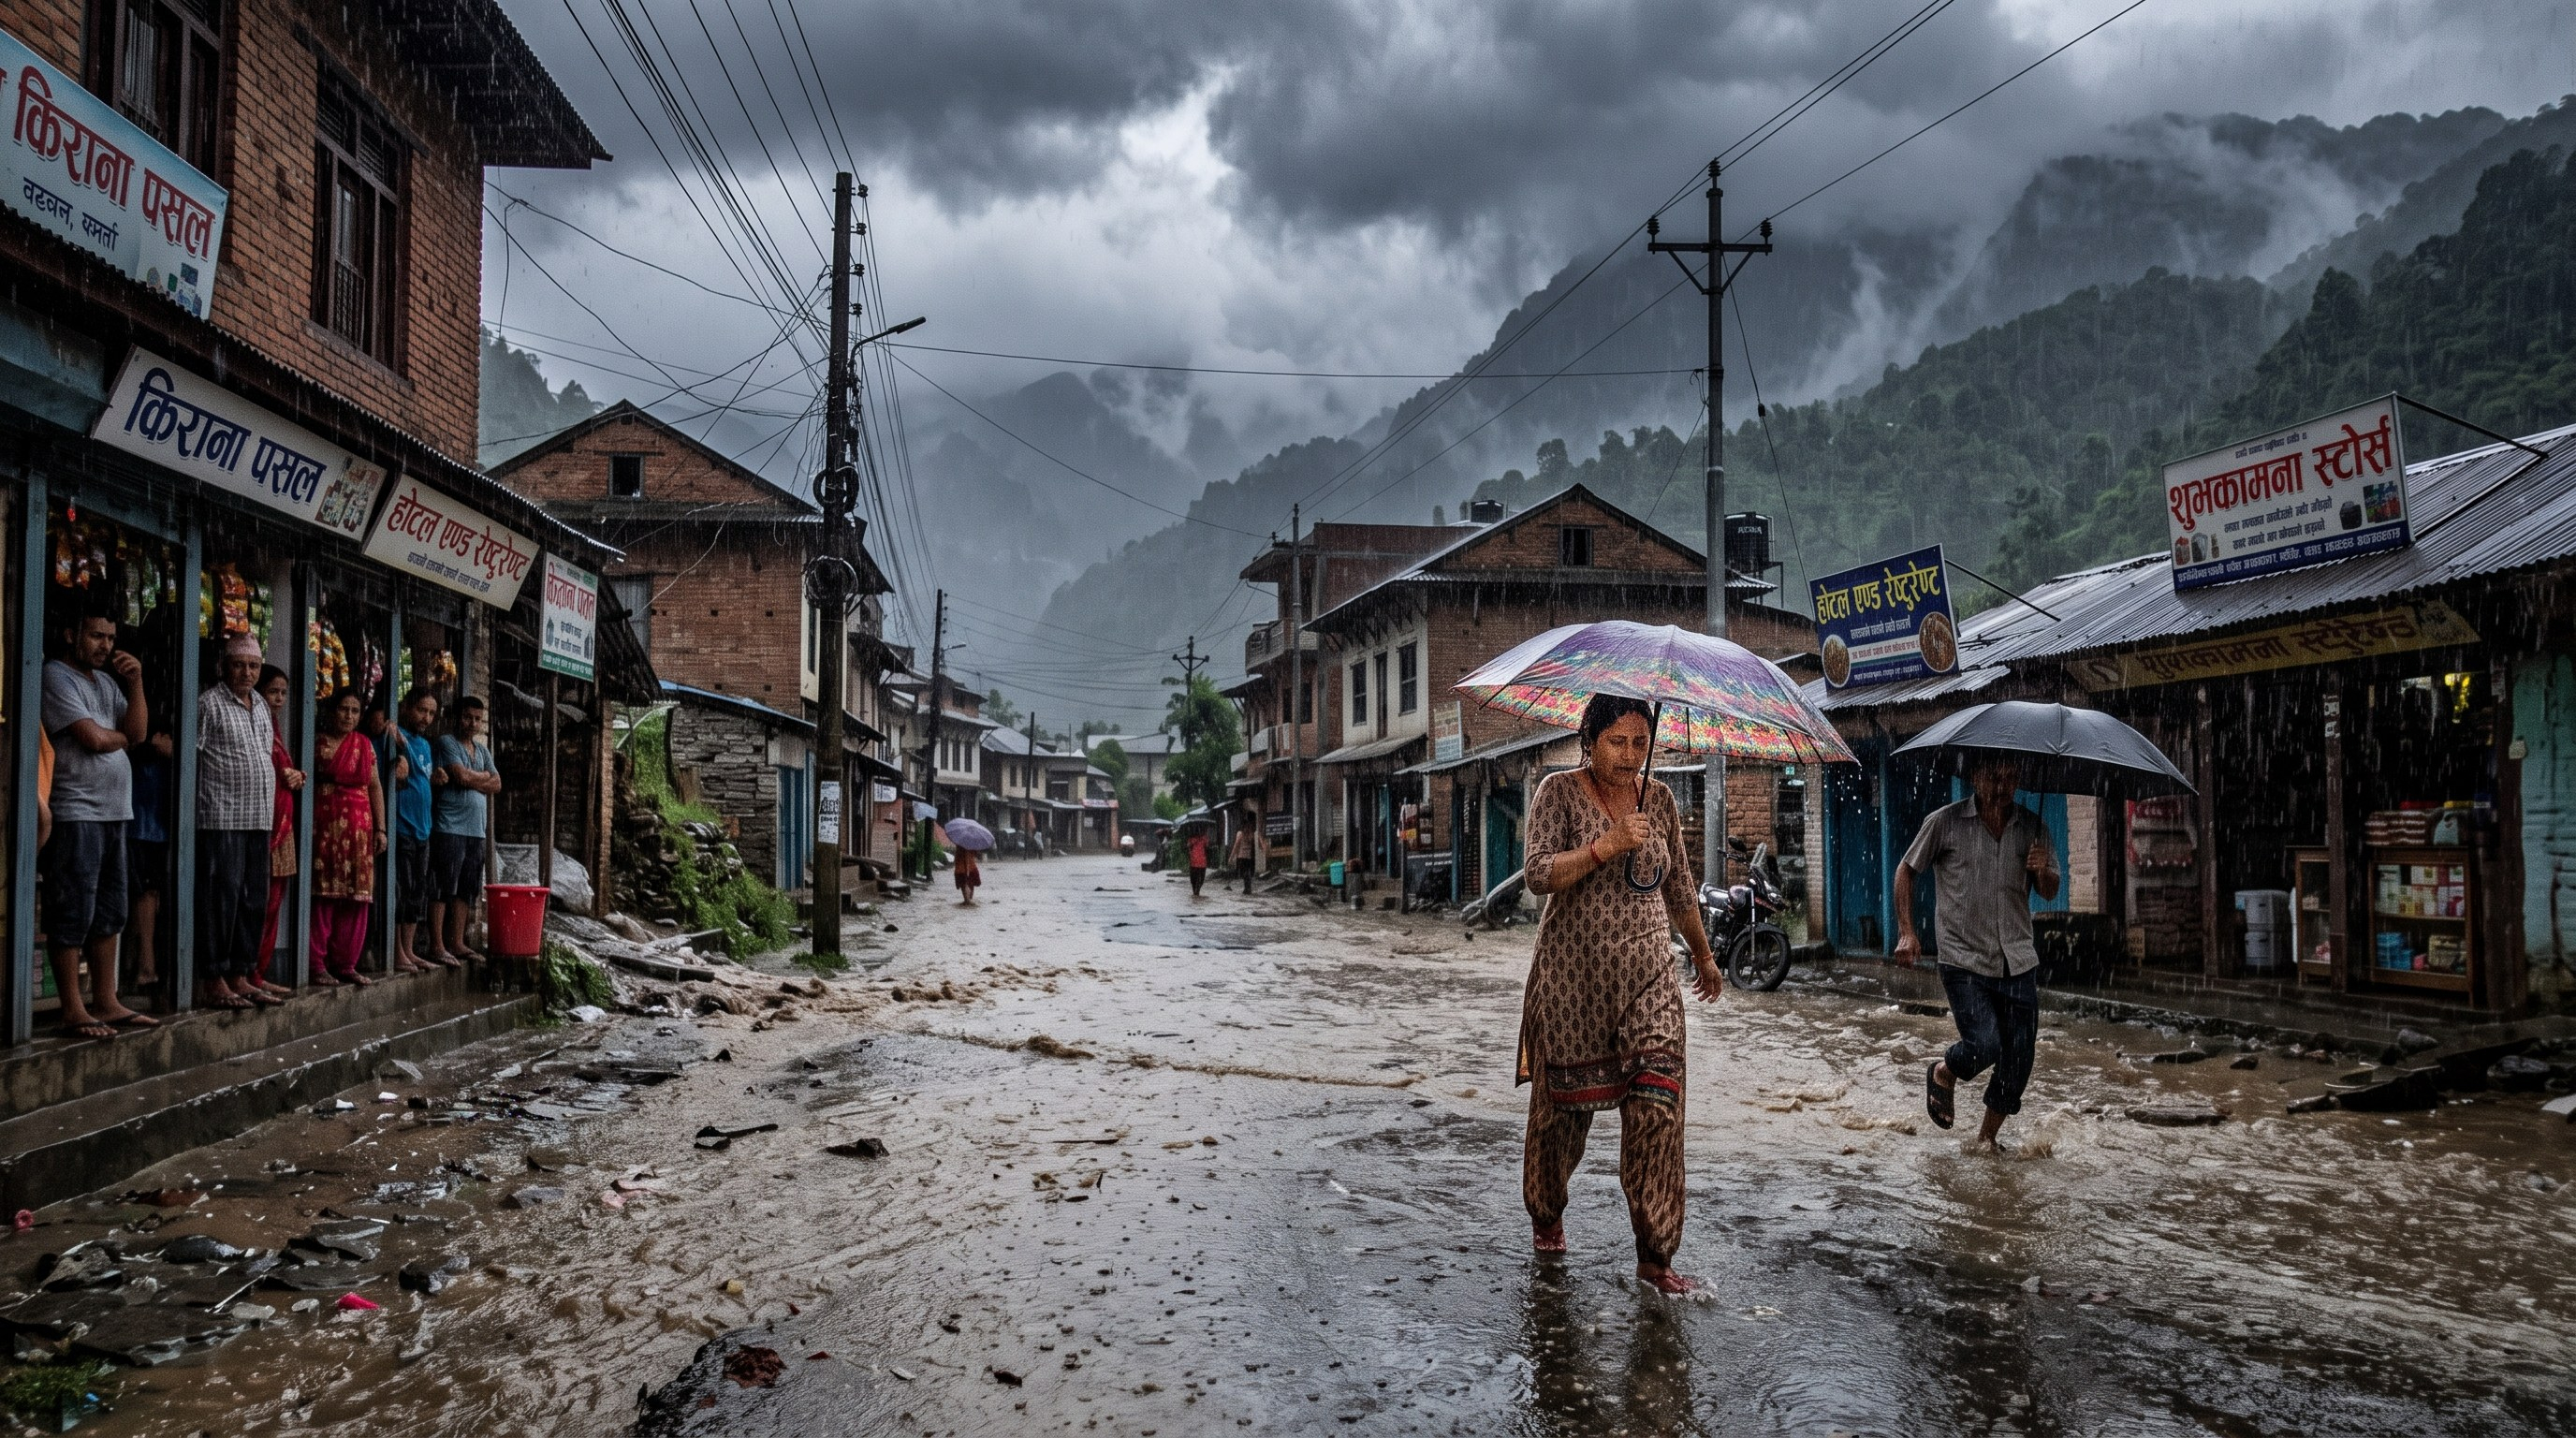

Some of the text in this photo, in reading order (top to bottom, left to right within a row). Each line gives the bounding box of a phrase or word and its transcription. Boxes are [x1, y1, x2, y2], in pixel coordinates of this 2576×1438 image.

[13, 66, 215, 259] किराना पसल
[124, 368, 327, 503] किराना पसल
[2170, 451, 2303, 532] शुभकामना
[2312, 415, 2392, 488] स्टोर्स
[388, 488, 443, 543] होटल
[439, 519, 477, 556] एण्ड
[1816, 584, 1850, 624] होटल
[1852, 580, 1881, 613] एण्ड
